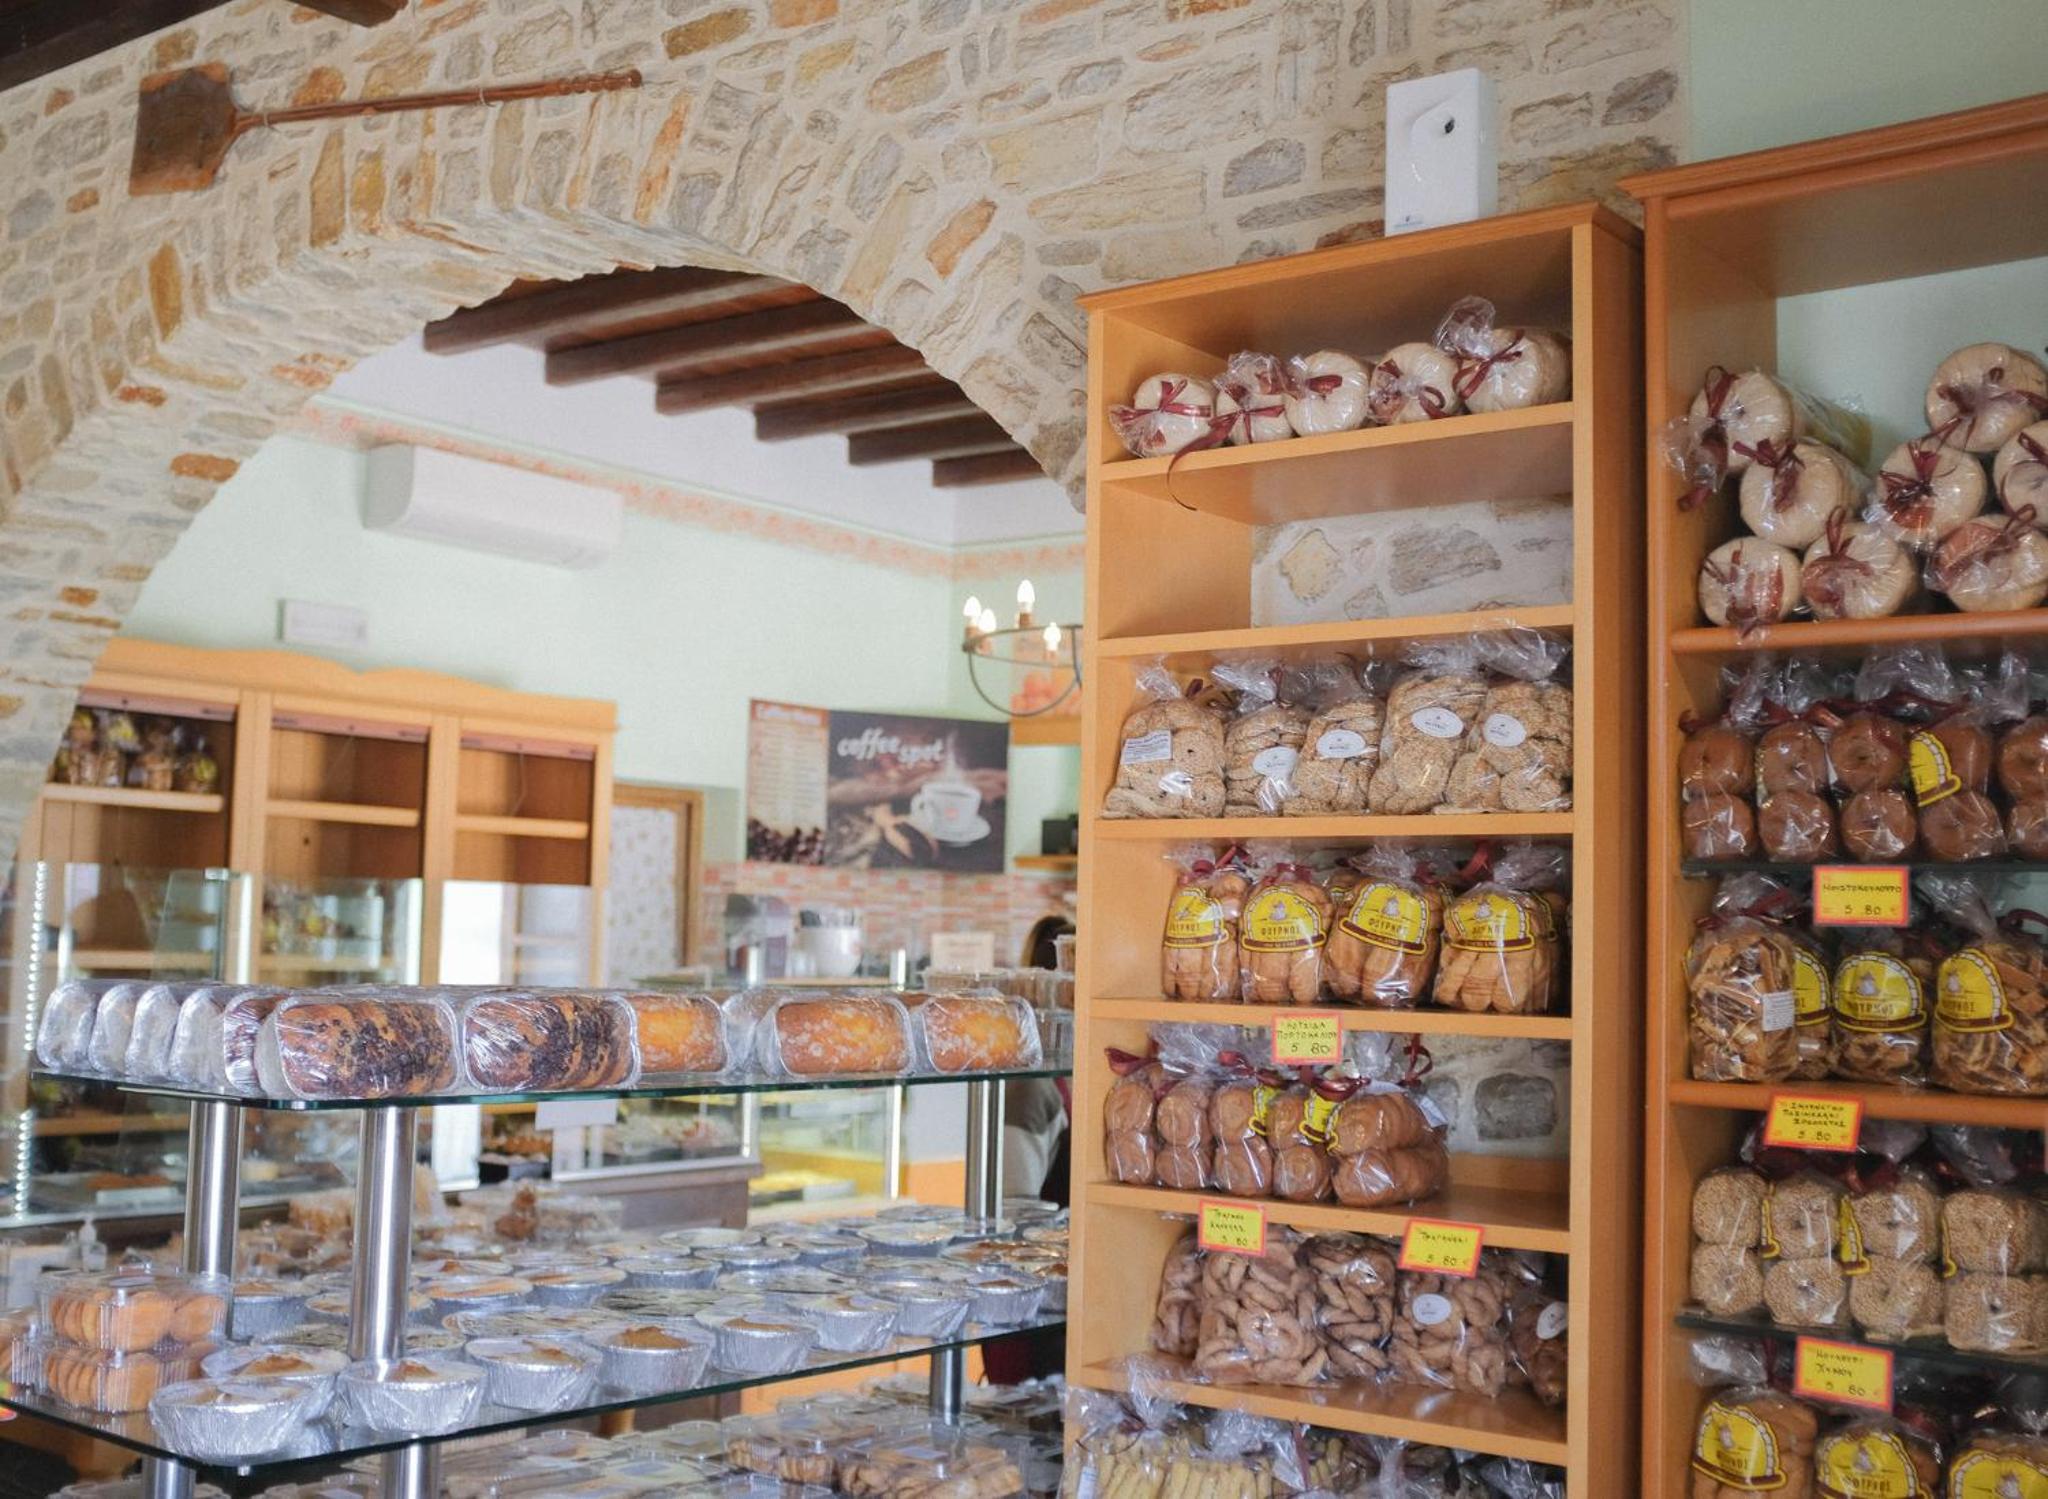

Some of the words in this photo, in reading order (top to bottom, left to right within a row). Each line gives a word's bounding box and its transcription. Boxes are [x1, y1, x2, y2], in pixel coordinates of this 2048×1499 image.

[837, 727, 899, 760] coffee
[897, 738, 944, 768] spot
[1844, 904, 1853, 915] 5
[1864, 904, 1882, 915] 80
[1291, 1042, 1300, 1053] 5
[1310, 1042, 1330, 1055] 80
[1816, 1131, 1832, 1141] 80
[1236, 1238, 1248, 1246] 80
[1426, 1254, 1434, 1263] 5
[1443, 1256, 1457, 1266] 80
[1848, 1384, 1866, 1396] 80
